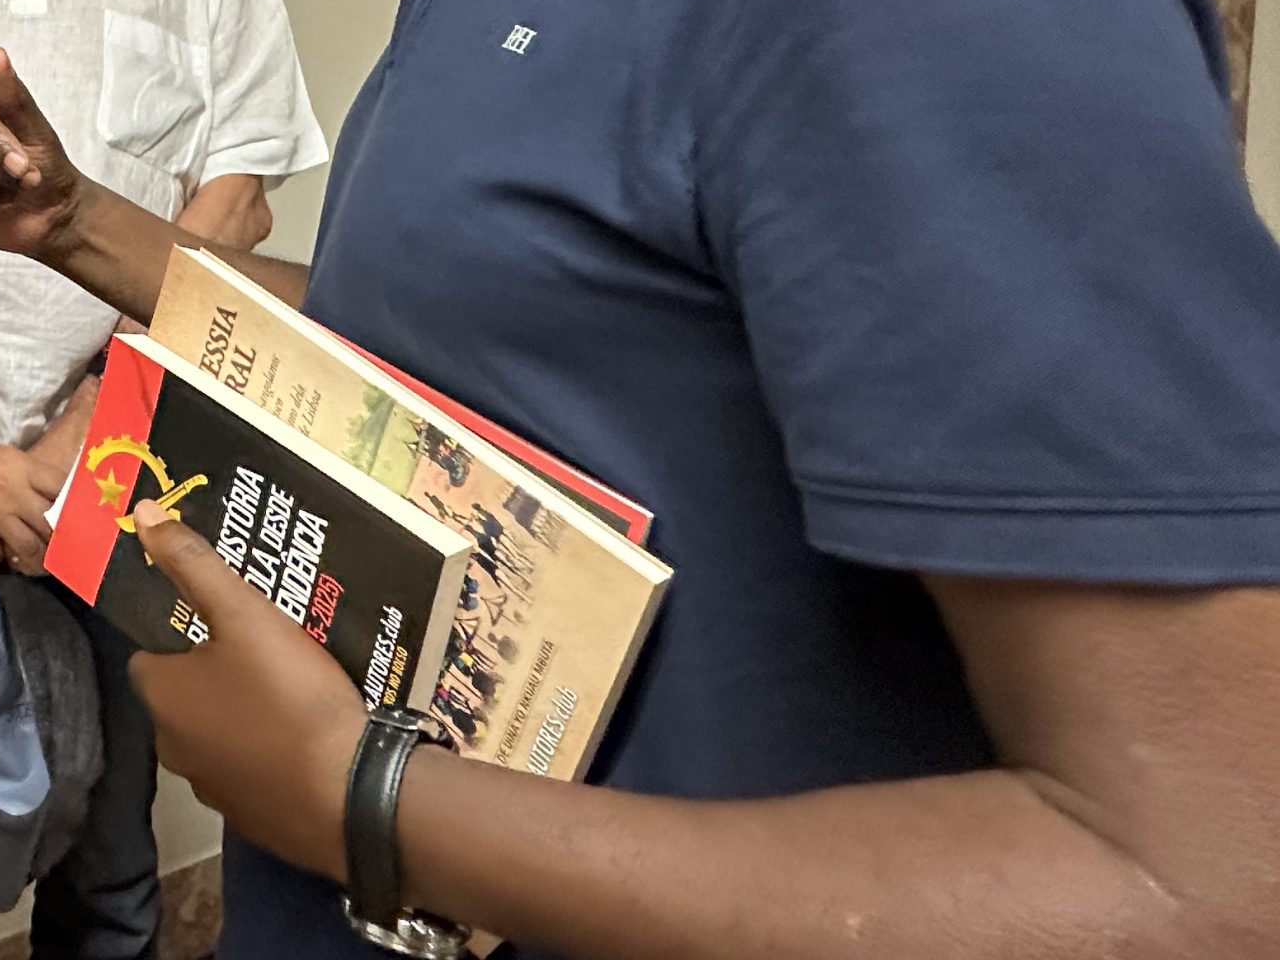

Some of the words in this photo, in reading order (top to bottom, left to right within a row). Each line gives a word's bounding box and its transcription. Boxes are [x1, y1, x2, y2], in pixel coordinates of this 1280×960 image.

[302, 389, 322, 427] Lisboa
[259, 483, 296, 552] DESDE
[274, 509, 329, 626] ENDÊNCIA
[170, 598, 192, 634] RUI
[306, 573, 346, 644] 5-2025)
[391, 645, 408, 676] BOLSO
